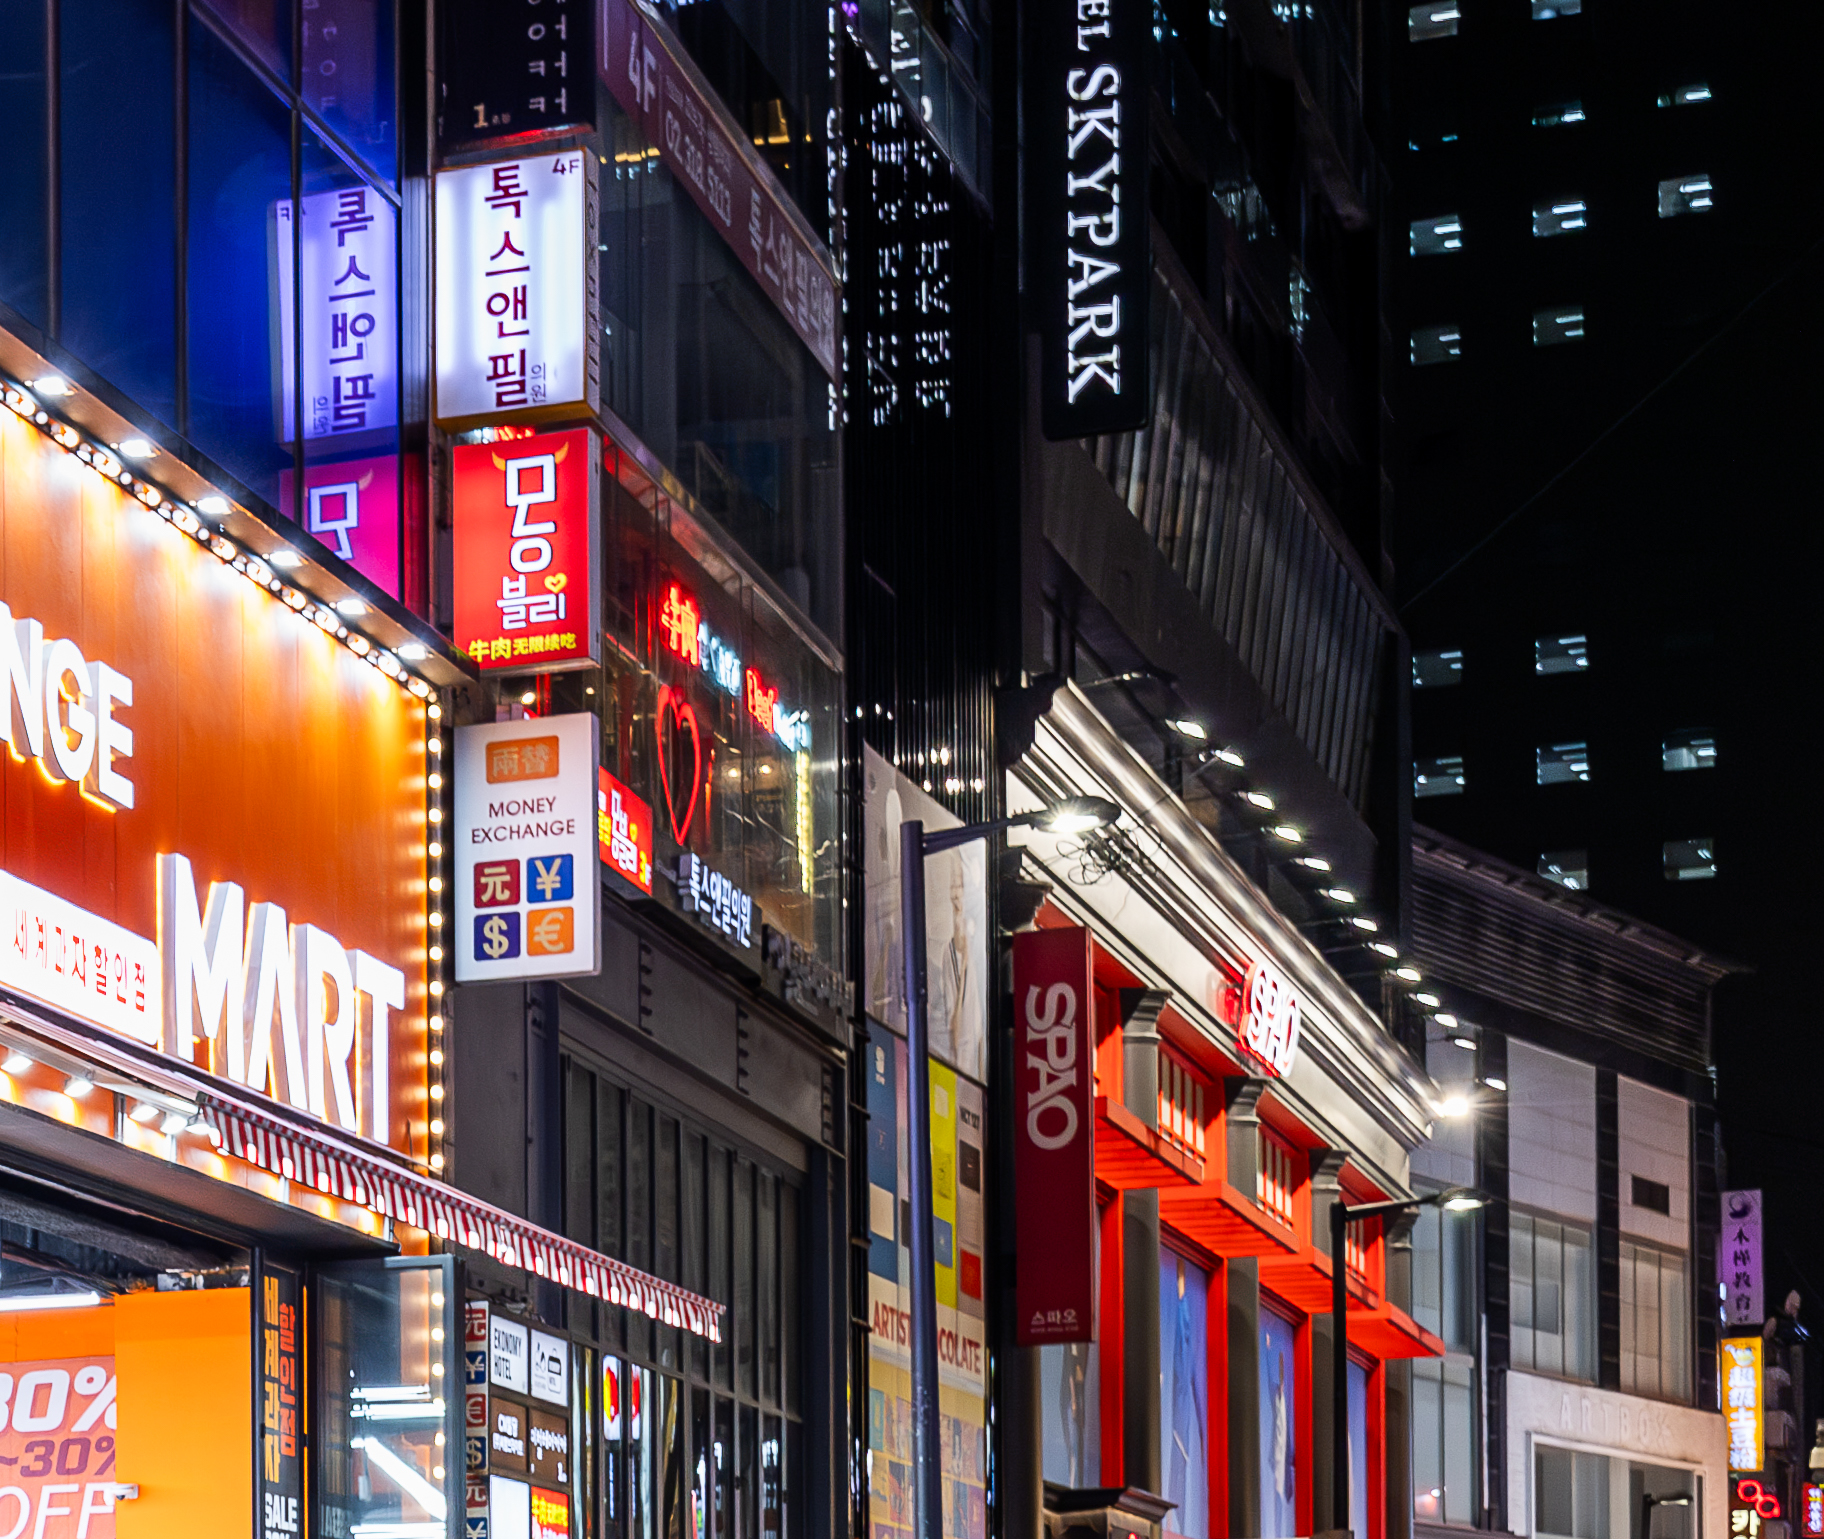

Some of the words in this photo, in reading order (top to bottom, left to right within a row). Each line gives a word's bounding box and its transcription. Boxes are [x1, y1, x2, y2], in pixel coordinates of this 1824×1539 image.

[528, 0, 568, 115] 어커커
[552, 158, 580, 176] 4F
[1067, 62, 1121, 404] SKYPARK
[484, 164, 530, 408] 톡스앤필
[488, 796, 557, 818] MONEY
[471, 818, 576, 845] EXCHANGE
[480, 865, 511, 903] 元
[533, 857, 562, 900] ¥
[482, 915, 509, 959] $
[532, 911, 566, 953] €
[157, 852, 405, 1147] MART
[1245, 961, 1302, 1079] SPAO
[1024, 980, 1079, 1152] SPAO
[1030, 1307, 1080, 1327] 스파오
[493, 1326, 523, 1359] EKONOMY
[936, 1326, 982, 1376] COLATE
[493, 1352, 513, 1382] HOTEL
[264, 1492, 298, 1534] SALE
